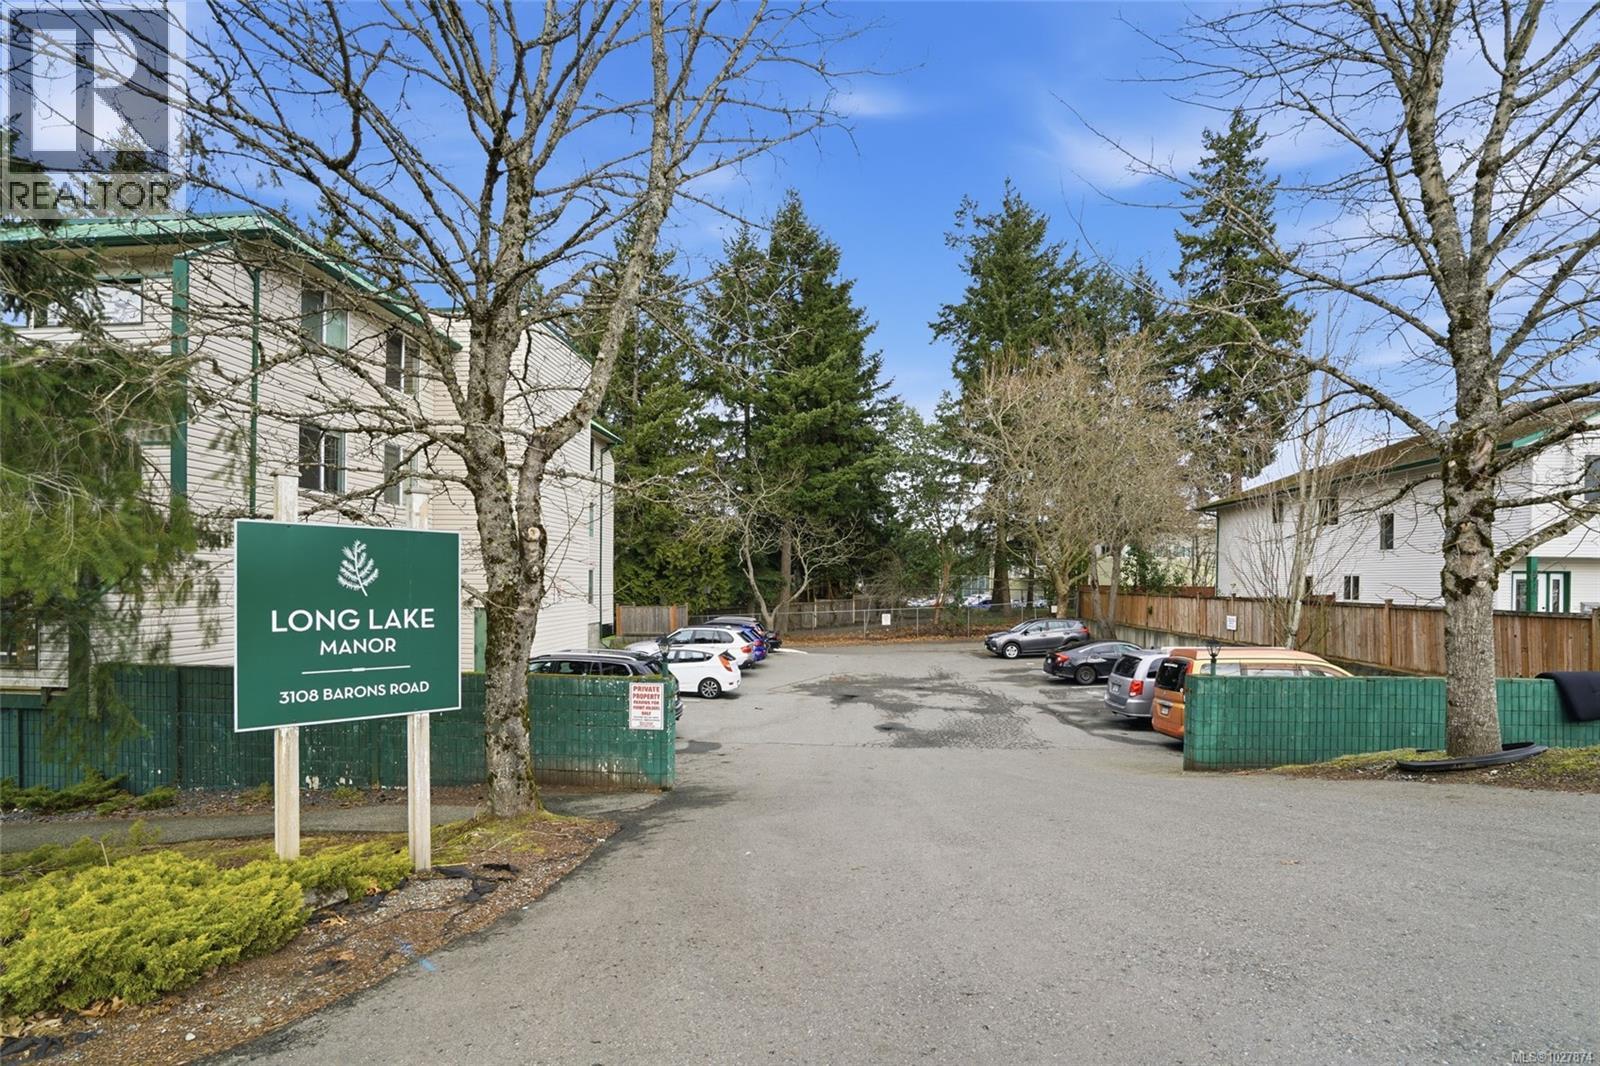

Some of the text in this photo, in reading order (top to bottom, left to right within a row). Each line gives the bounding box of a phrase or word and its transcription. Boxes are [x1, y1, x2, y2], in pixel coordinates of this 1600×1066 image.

[271, 607, 435, 633] LONG LAKE
[319, 637, 396, 656] MANOR
[278, 680, 430, 704] 3108 BARONS ROAD
